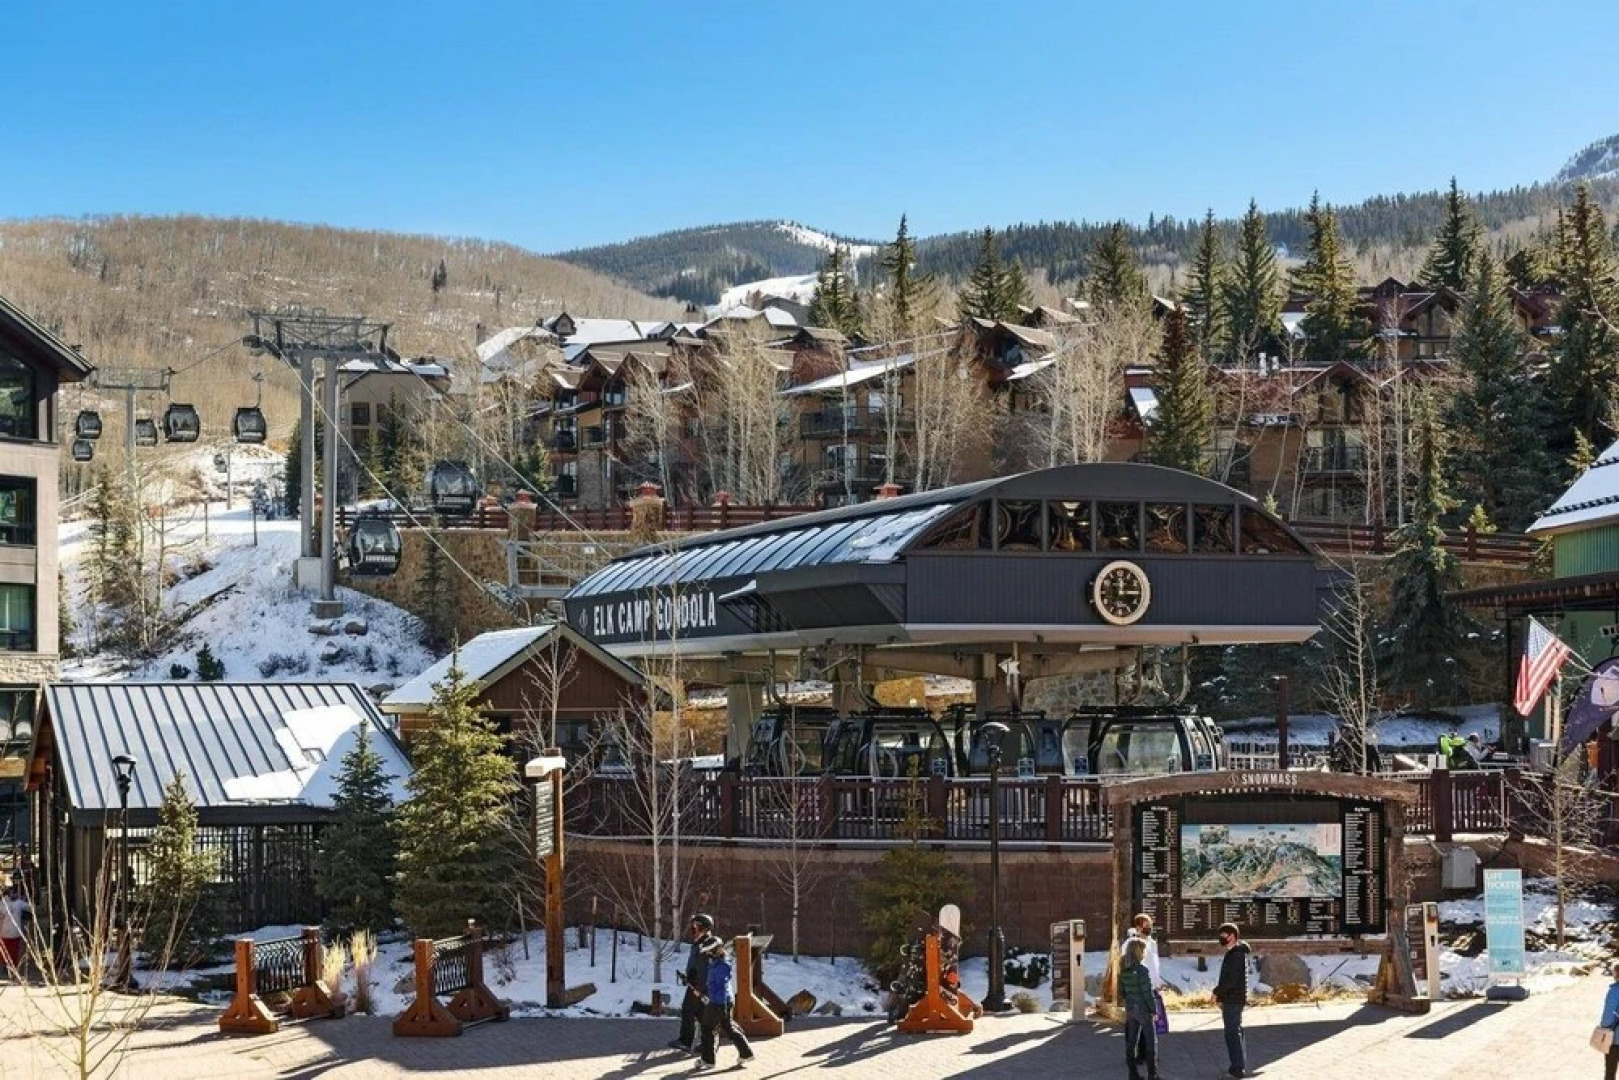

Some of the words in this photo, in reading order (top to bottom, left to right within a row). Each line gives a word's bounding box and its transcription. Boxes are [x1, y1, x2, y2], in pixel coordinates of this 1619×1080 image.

[594, 604, 614, 635] ELK
[618, 599, 650, 633] CAMP
[1241, 773, 1298, 785] SNOWMASS
